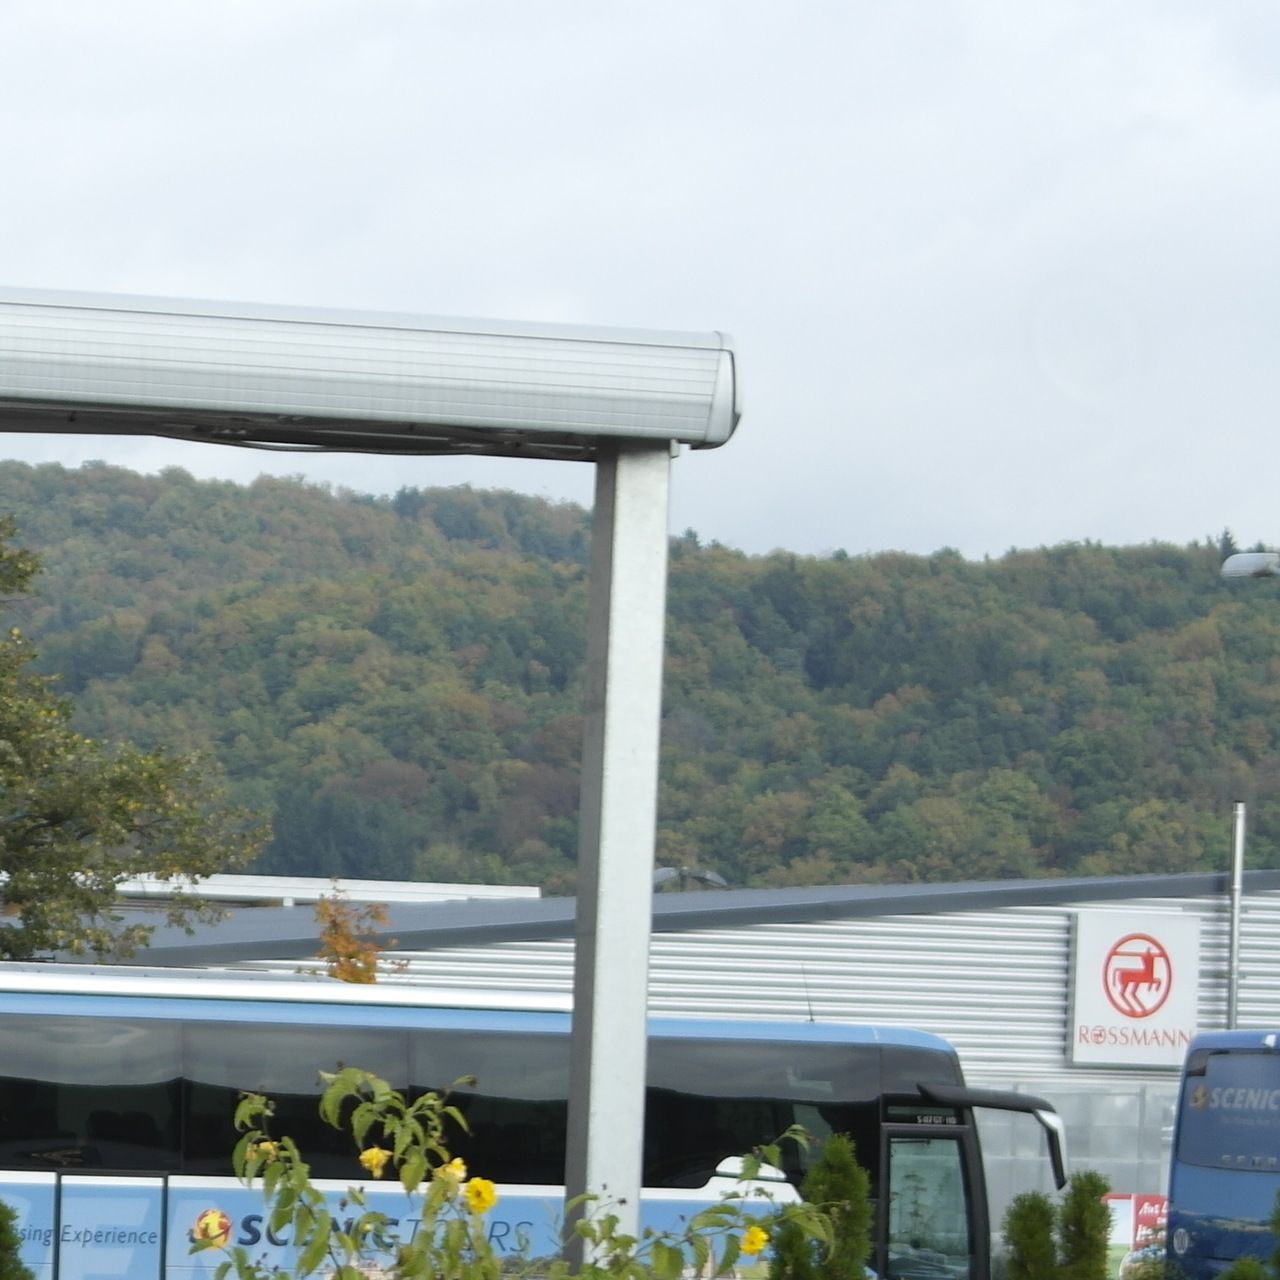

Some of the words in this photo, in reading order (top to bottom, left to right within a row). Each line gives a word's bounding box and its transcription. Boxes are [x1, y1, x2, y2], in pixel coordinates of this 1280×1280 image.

[1078, 1024, 1192, 1047] ROSSMANN
[1221, 1154, 1280, 1167] SETR
[60, 1224, 158, 1248] Experience
